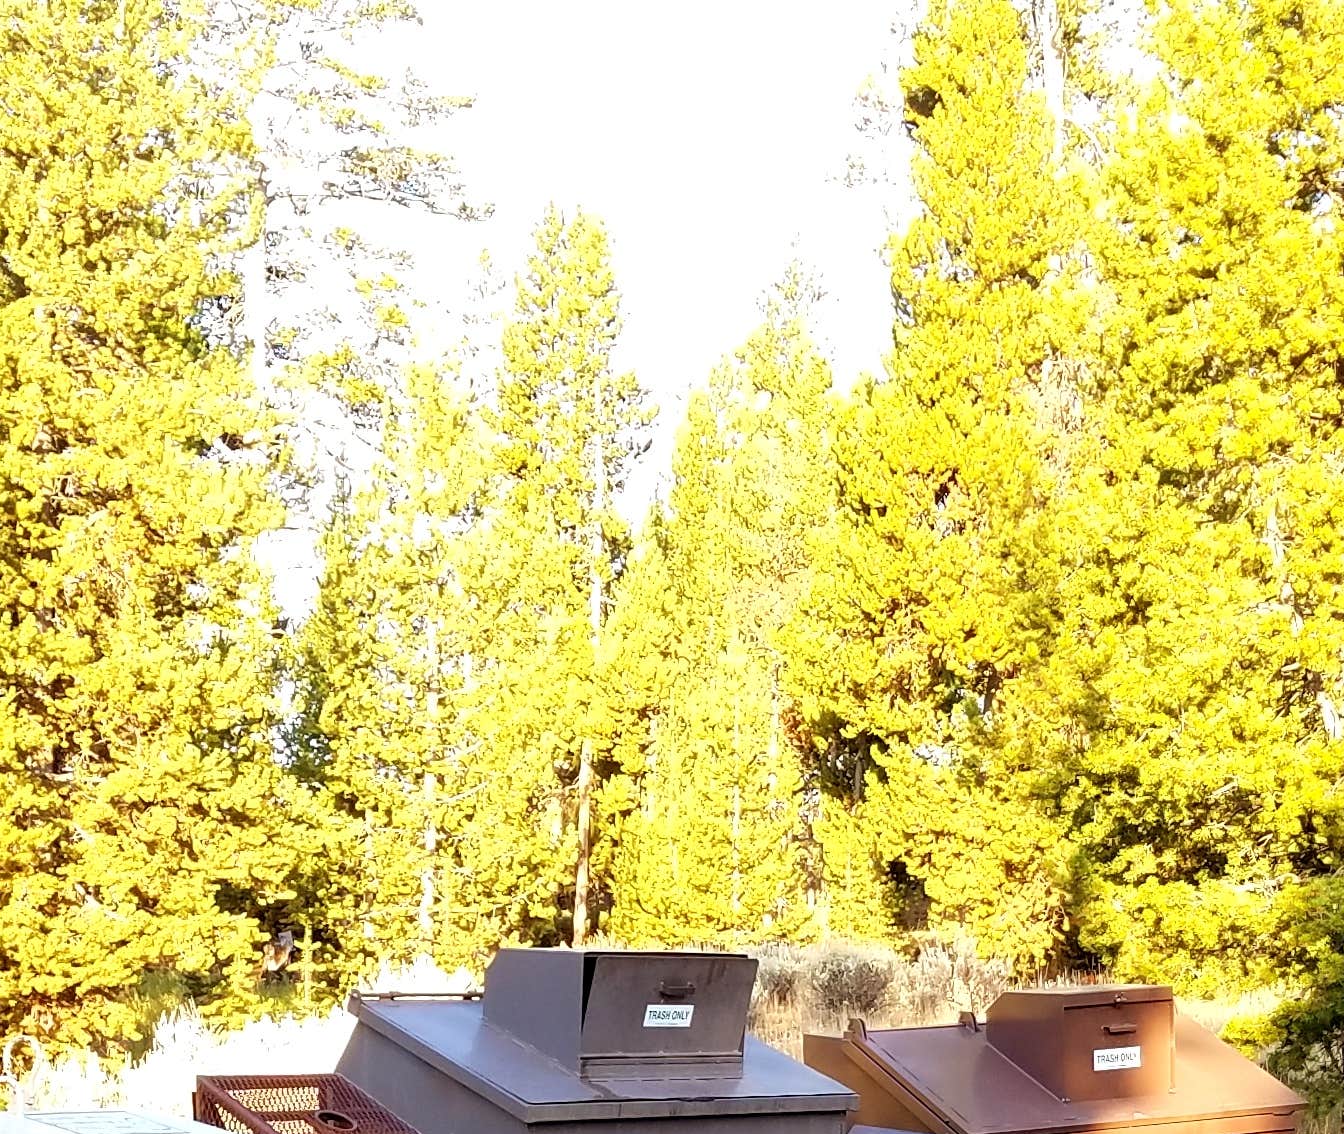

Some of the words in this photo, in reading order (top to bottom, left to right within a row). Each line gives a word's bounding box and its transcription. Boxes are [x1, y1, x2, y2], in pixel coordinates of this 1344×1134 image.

[648, 1010, 672, 1020] TRASH
[672, 1010, 690, 1020] ONLY
[1097, 1053, 1119, 1064] TRASH
